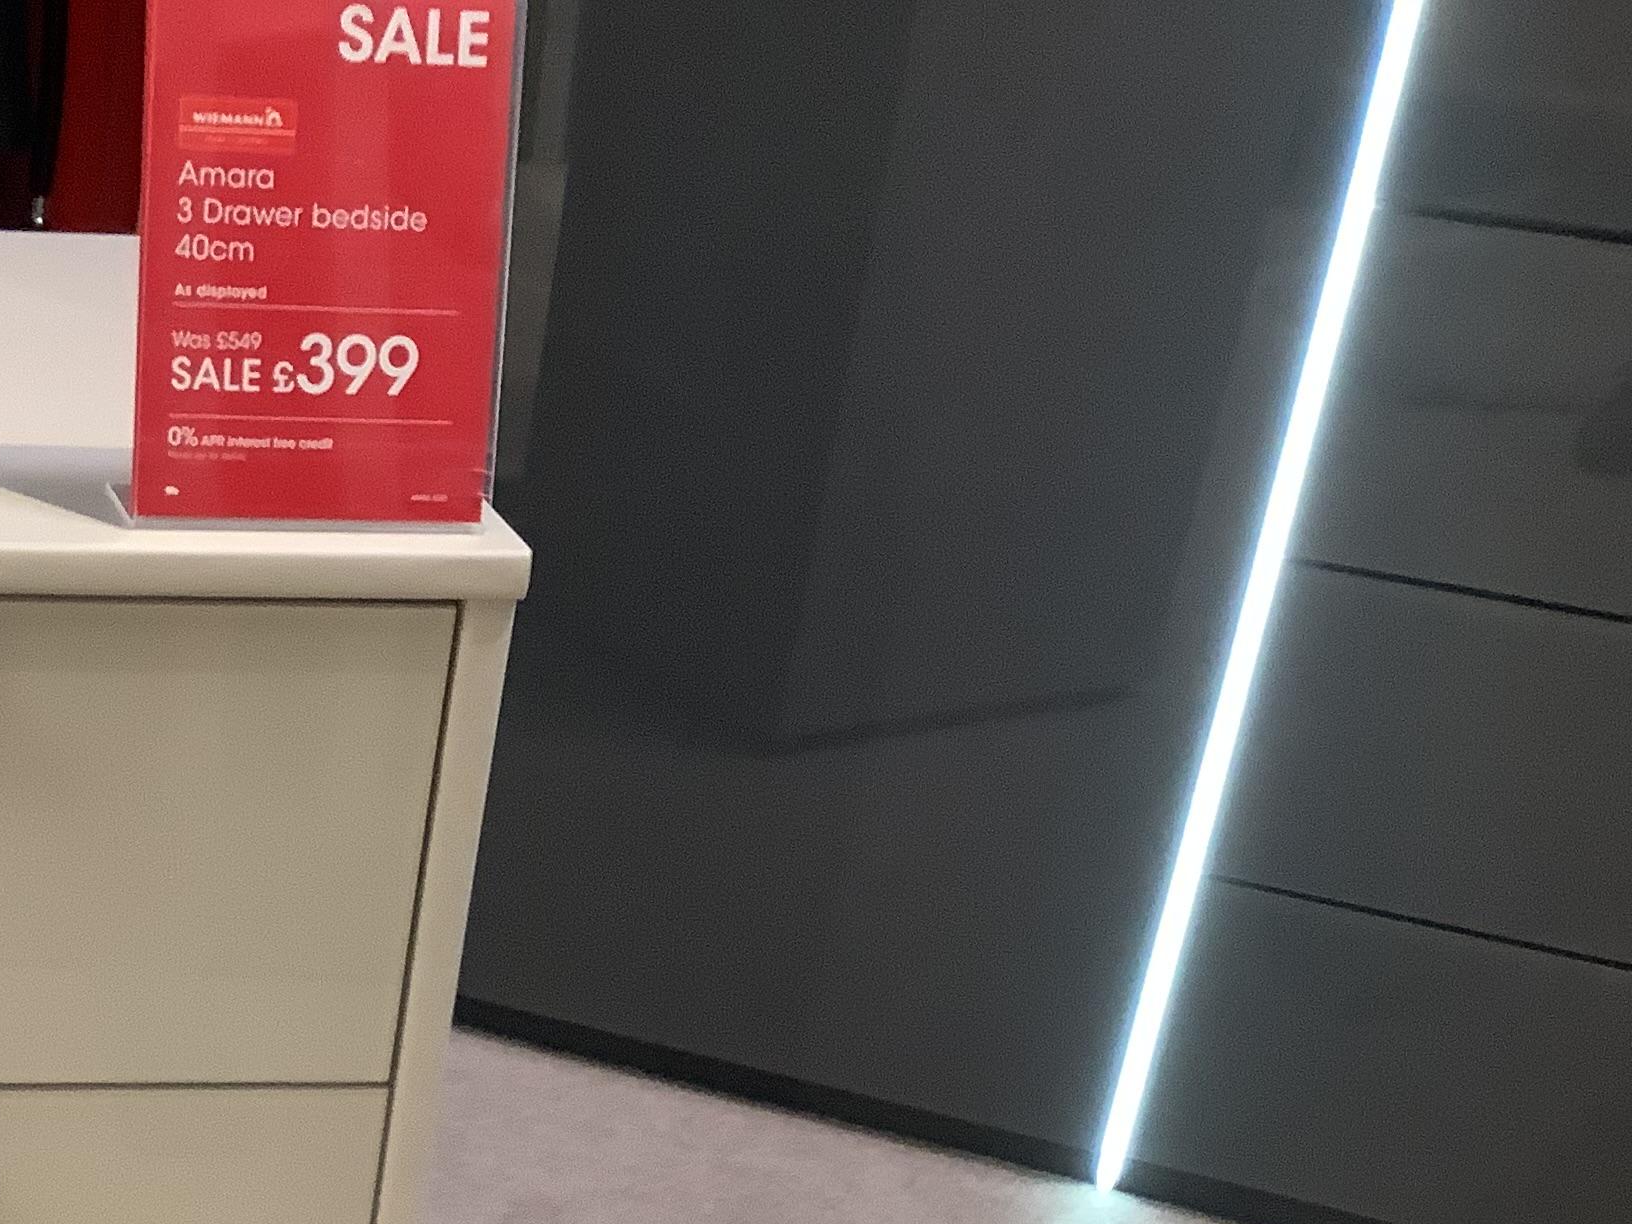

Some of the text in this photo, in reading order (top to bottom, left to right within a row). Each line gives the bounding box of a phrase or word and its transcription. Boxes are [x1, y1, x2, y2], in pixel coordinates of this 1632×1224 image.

[338, 3, 490, 68] SALE
[178, 160, 275, 189] Amara
[176, 197, 428, 232] 3 Drawer bedside
[174, 233, 255, 262] 40cm
[174, 283, 268, 300] As displayed
[171, 330, 263, 351] Was £549
[171, 332, 420, 396] SALE £399
[168, 425, 199, 447] 0%
